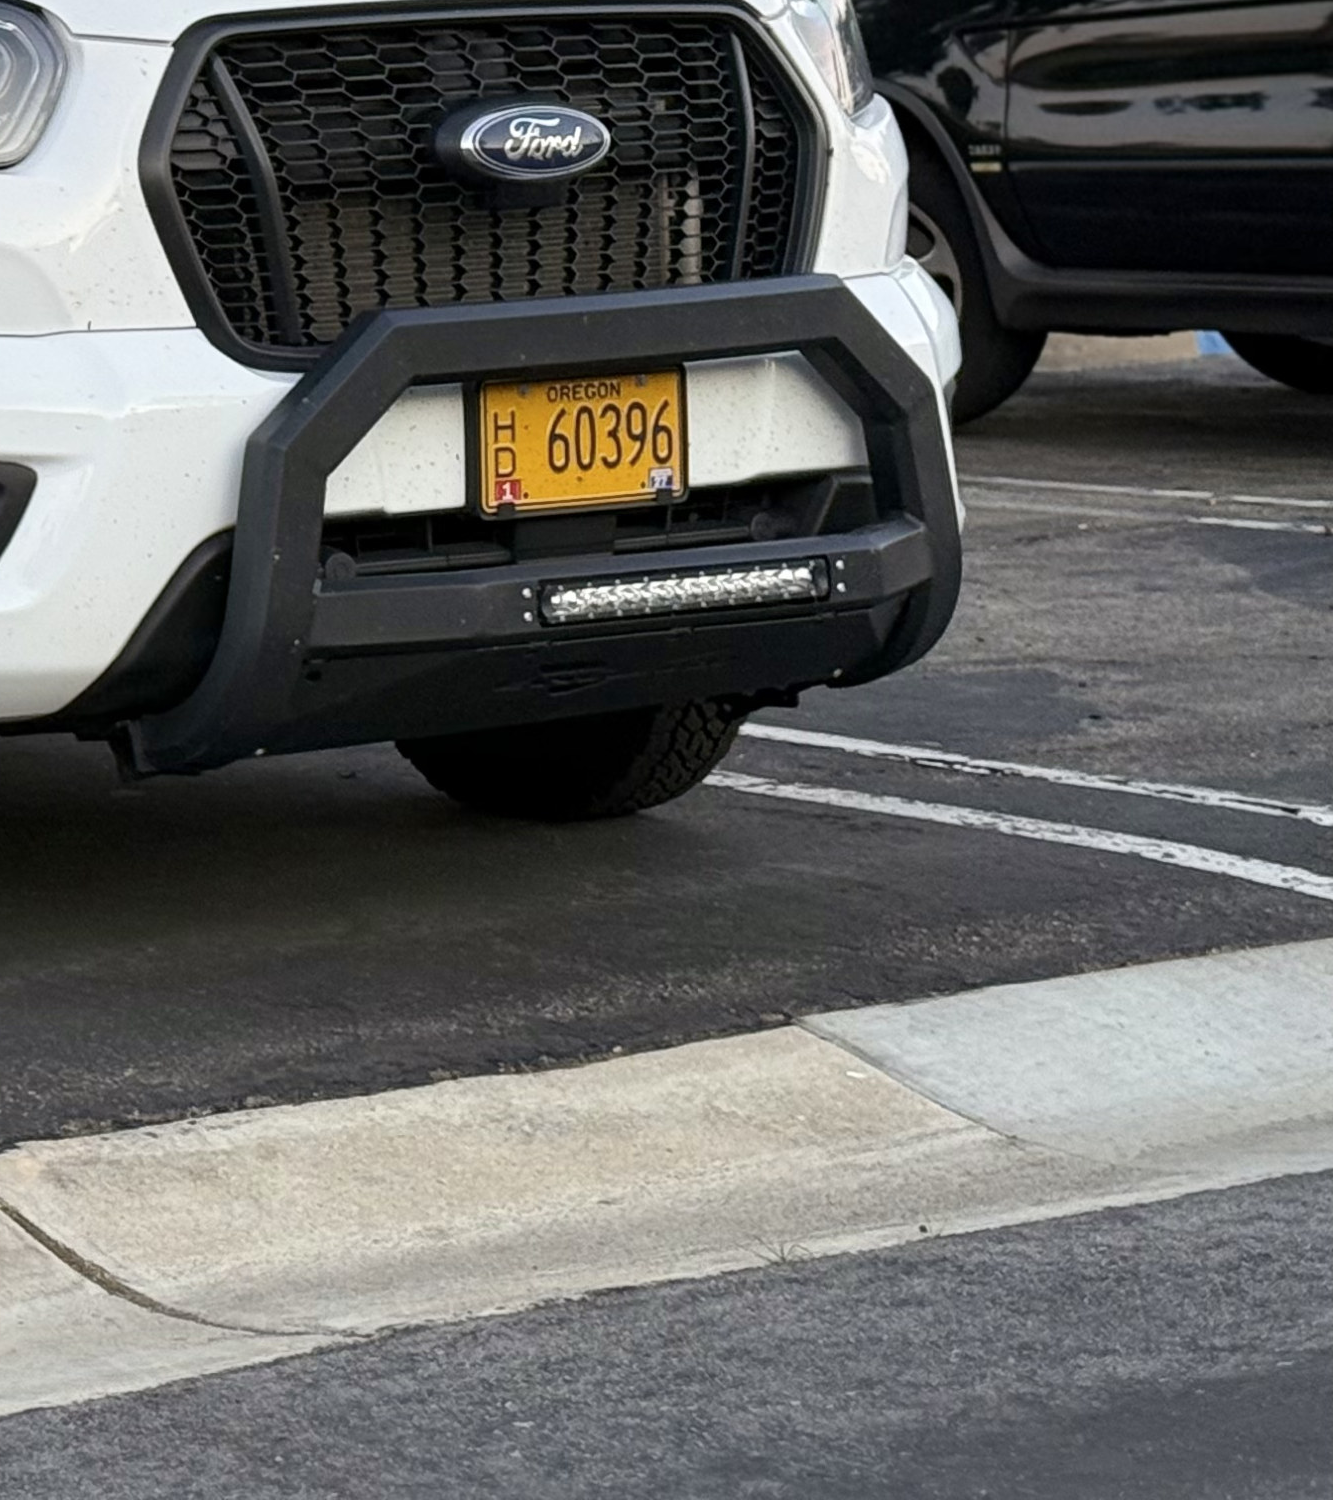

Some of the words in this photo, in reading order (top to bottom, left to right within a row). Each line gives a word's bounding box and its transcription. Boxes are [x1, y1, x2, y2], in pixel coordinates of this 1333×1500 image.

[504, 117, 583, 161] Ford
[546, 382, 622, 404] OREGON
[547, 399, 673, 474] 60396
